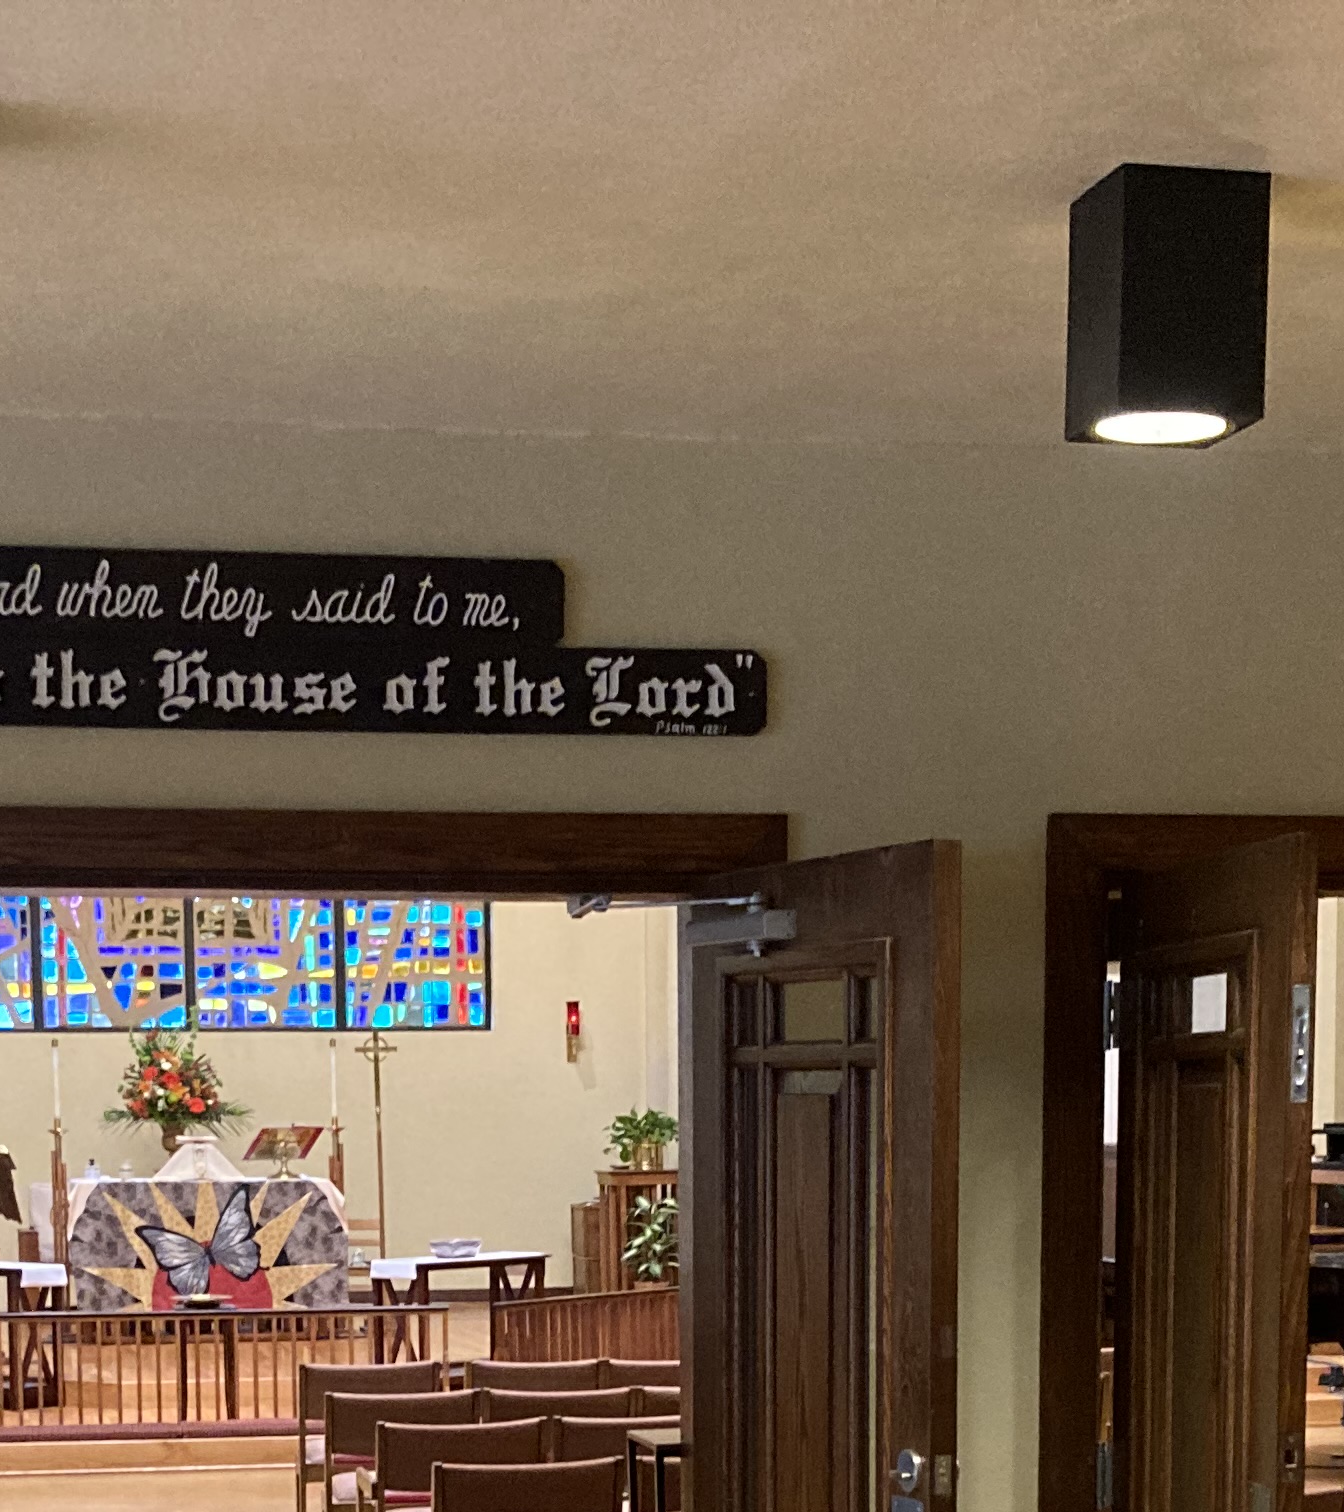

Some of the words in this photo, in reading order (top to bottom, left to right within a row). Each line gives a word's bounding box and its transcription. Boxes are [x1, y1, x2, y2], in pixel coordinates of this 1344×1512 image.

[56, 558, 164, 619] when
[180, 562, 273, 637] they
[291, 573, 396, 624] said
[413, 574, 449, 626] to
[462, 592, 520, 631] me,
[31, 648, 127, 710] the
[153, 649, 358, 722] House
[383, 656, 450, 714] of
[474, 658, 565, 716] the
[656, 719, 696, 735] Psalm
